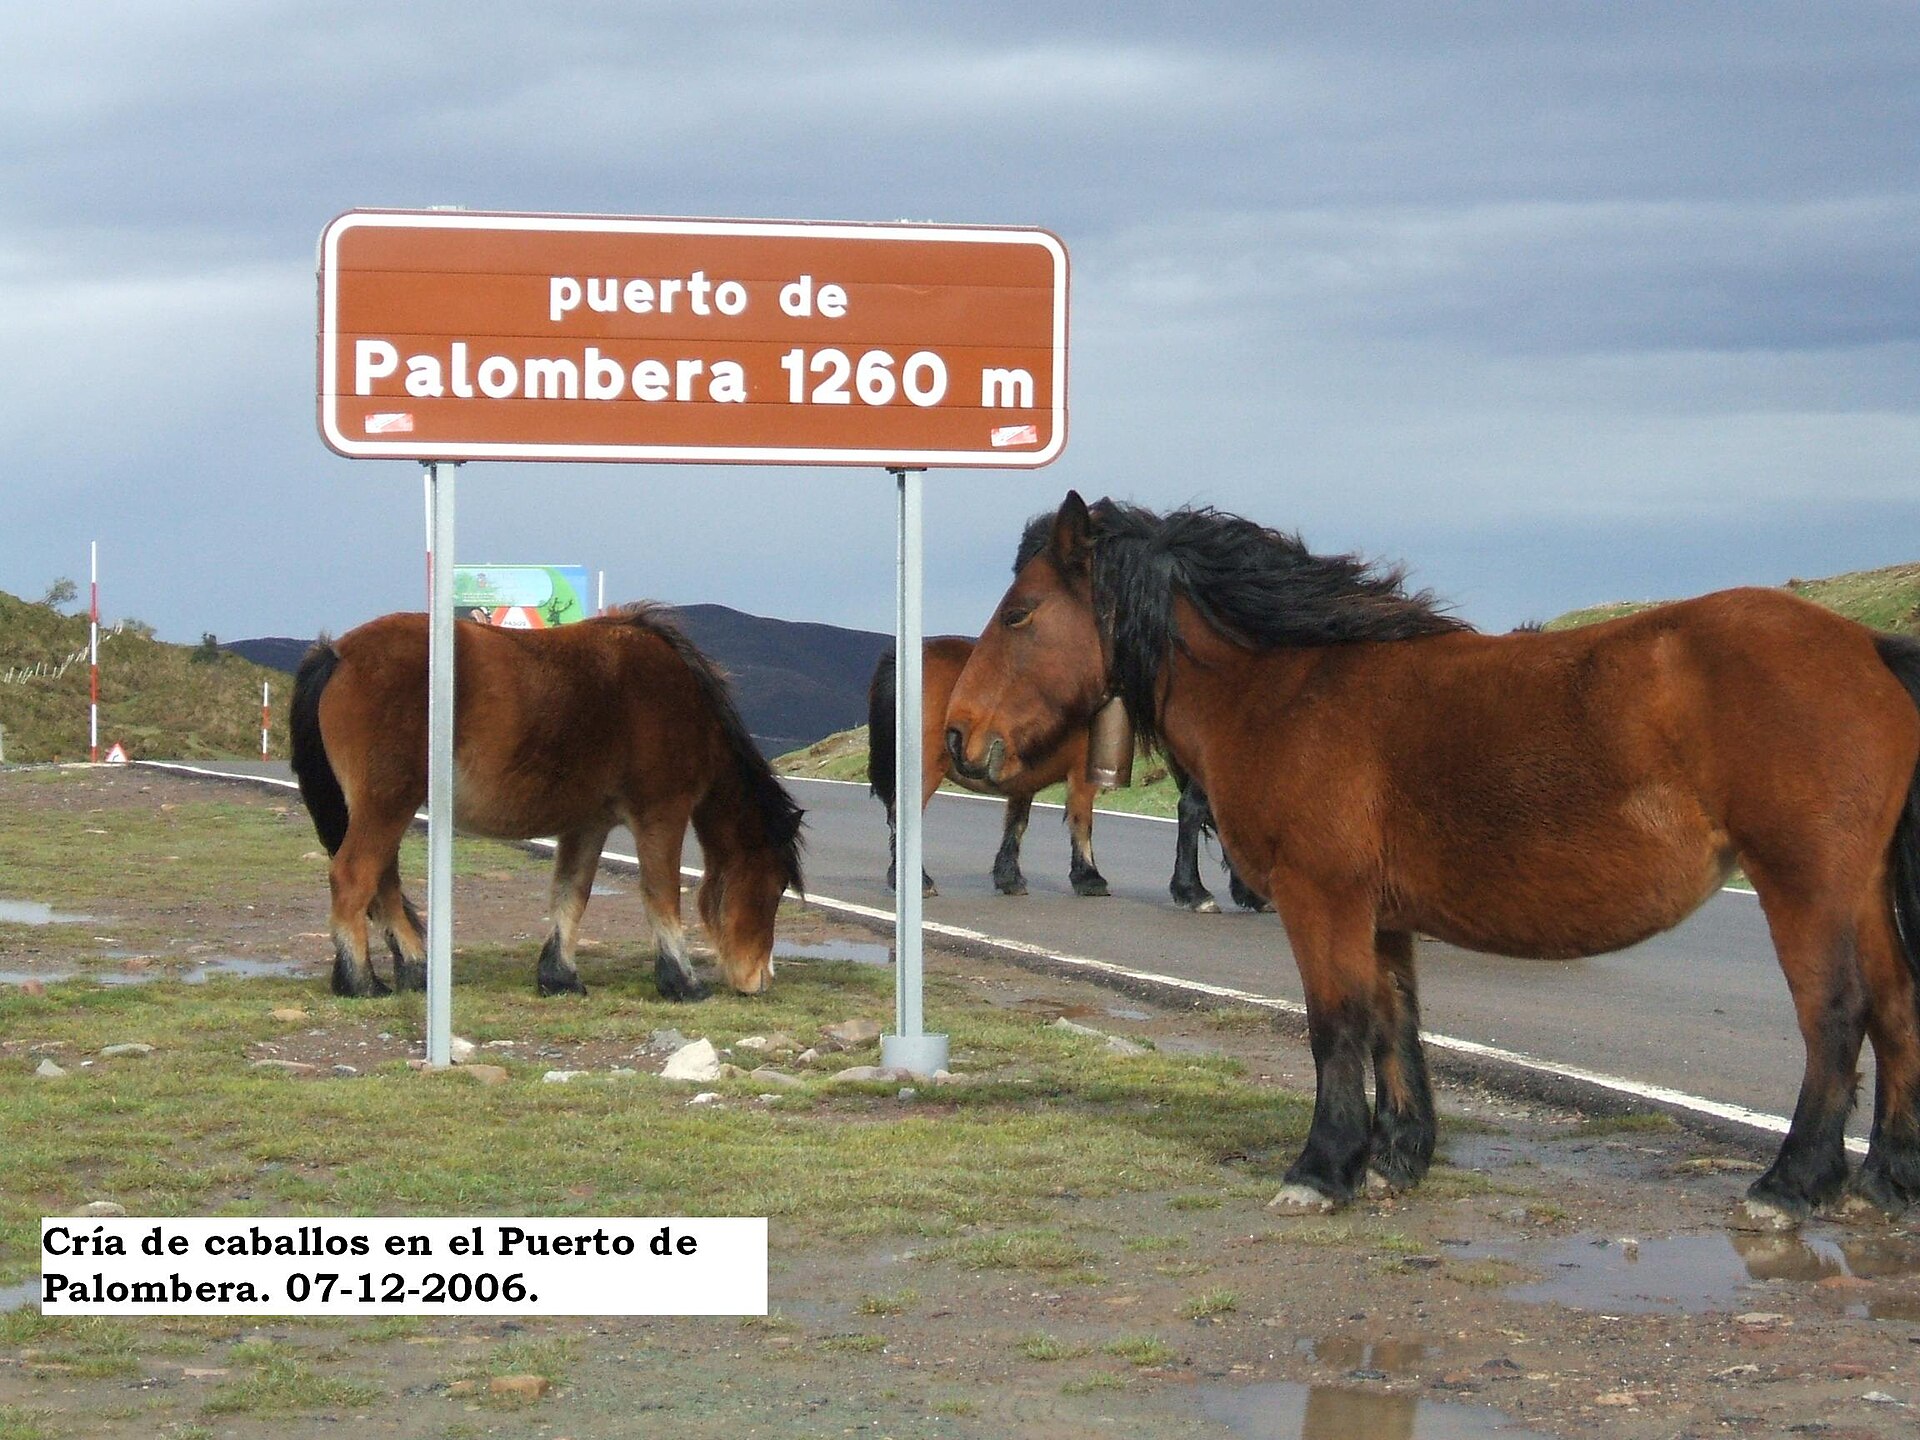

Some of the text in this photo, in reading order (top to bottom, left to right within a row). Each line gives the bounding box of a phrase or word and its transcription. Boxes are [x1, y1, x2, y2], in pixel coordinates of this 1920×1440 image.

[549, 270, 848, 322] puerto de
[355, 339, 1034, 409] Palombera 1260 m
